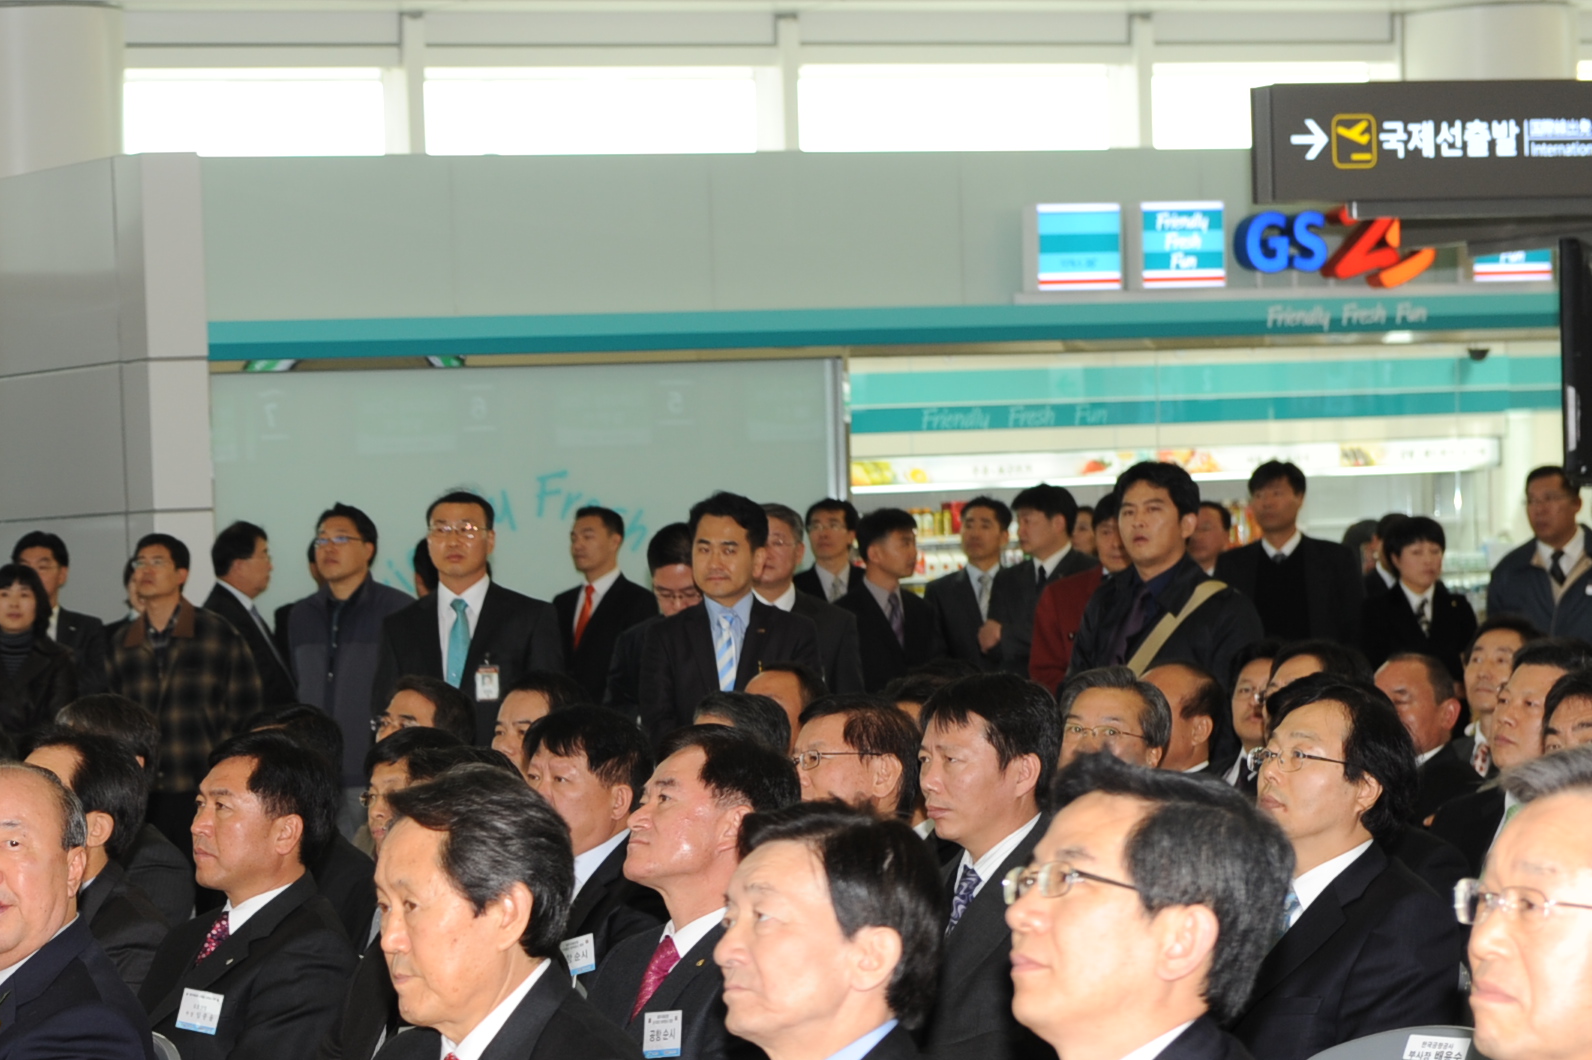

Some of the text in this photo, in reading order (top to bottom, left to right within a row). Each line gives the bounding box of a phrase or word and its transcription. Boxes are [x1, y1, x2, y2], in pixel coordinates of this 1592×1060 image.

[1379, 119, 1520, 158] 국제선출발
[1156, 211, 1209, 233] Friendly
[1164, 232, 1202, 251] Fresh
[1170, 251, 1198, 270] Fun
[1267, 302, 1428, 332] Friendly Fresh Fun
[921, 403, 1108, 431] Friendly Fresh Fun
[536, 470, 648, 552] Frh
[1421, 1041, 1454, 1050] 한국공항공사
